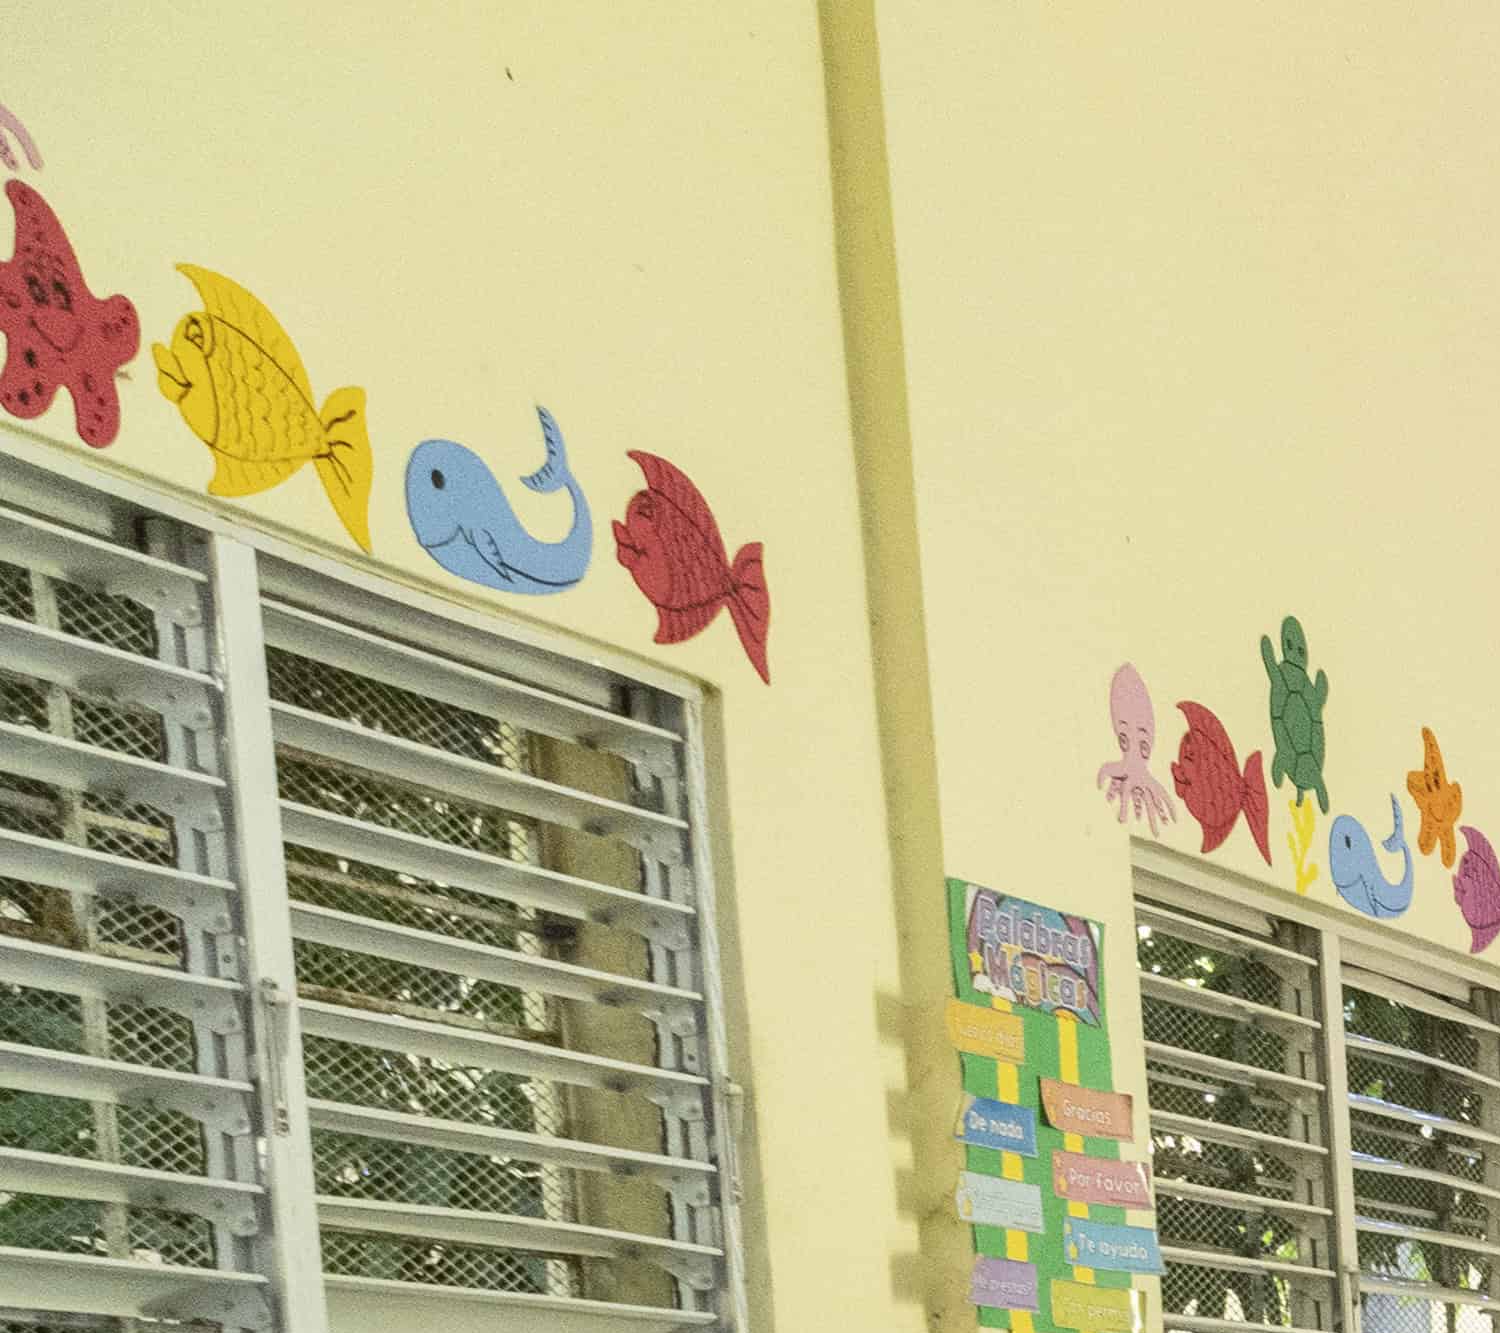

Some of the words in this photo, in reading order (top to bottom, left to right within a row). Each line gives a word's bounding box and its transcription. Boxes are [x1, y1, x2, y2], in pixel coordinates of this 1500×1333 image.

[977, 893, 1092, 970] Palabras
[985, 941, 1087, 1010] Mágicas
[968, 1110, 987, 1130] De
[989, 1116, 1025, 1140] nada
[1062, 1098, 1112, 1126] Gracias
[1068, 1166, 1090, 1188] Por
[1095, 1172, 1142, 1195] favor
[1077, 1233, 1096, 1253] Te
[1099, 1239, 1148, 1262] ayudo
